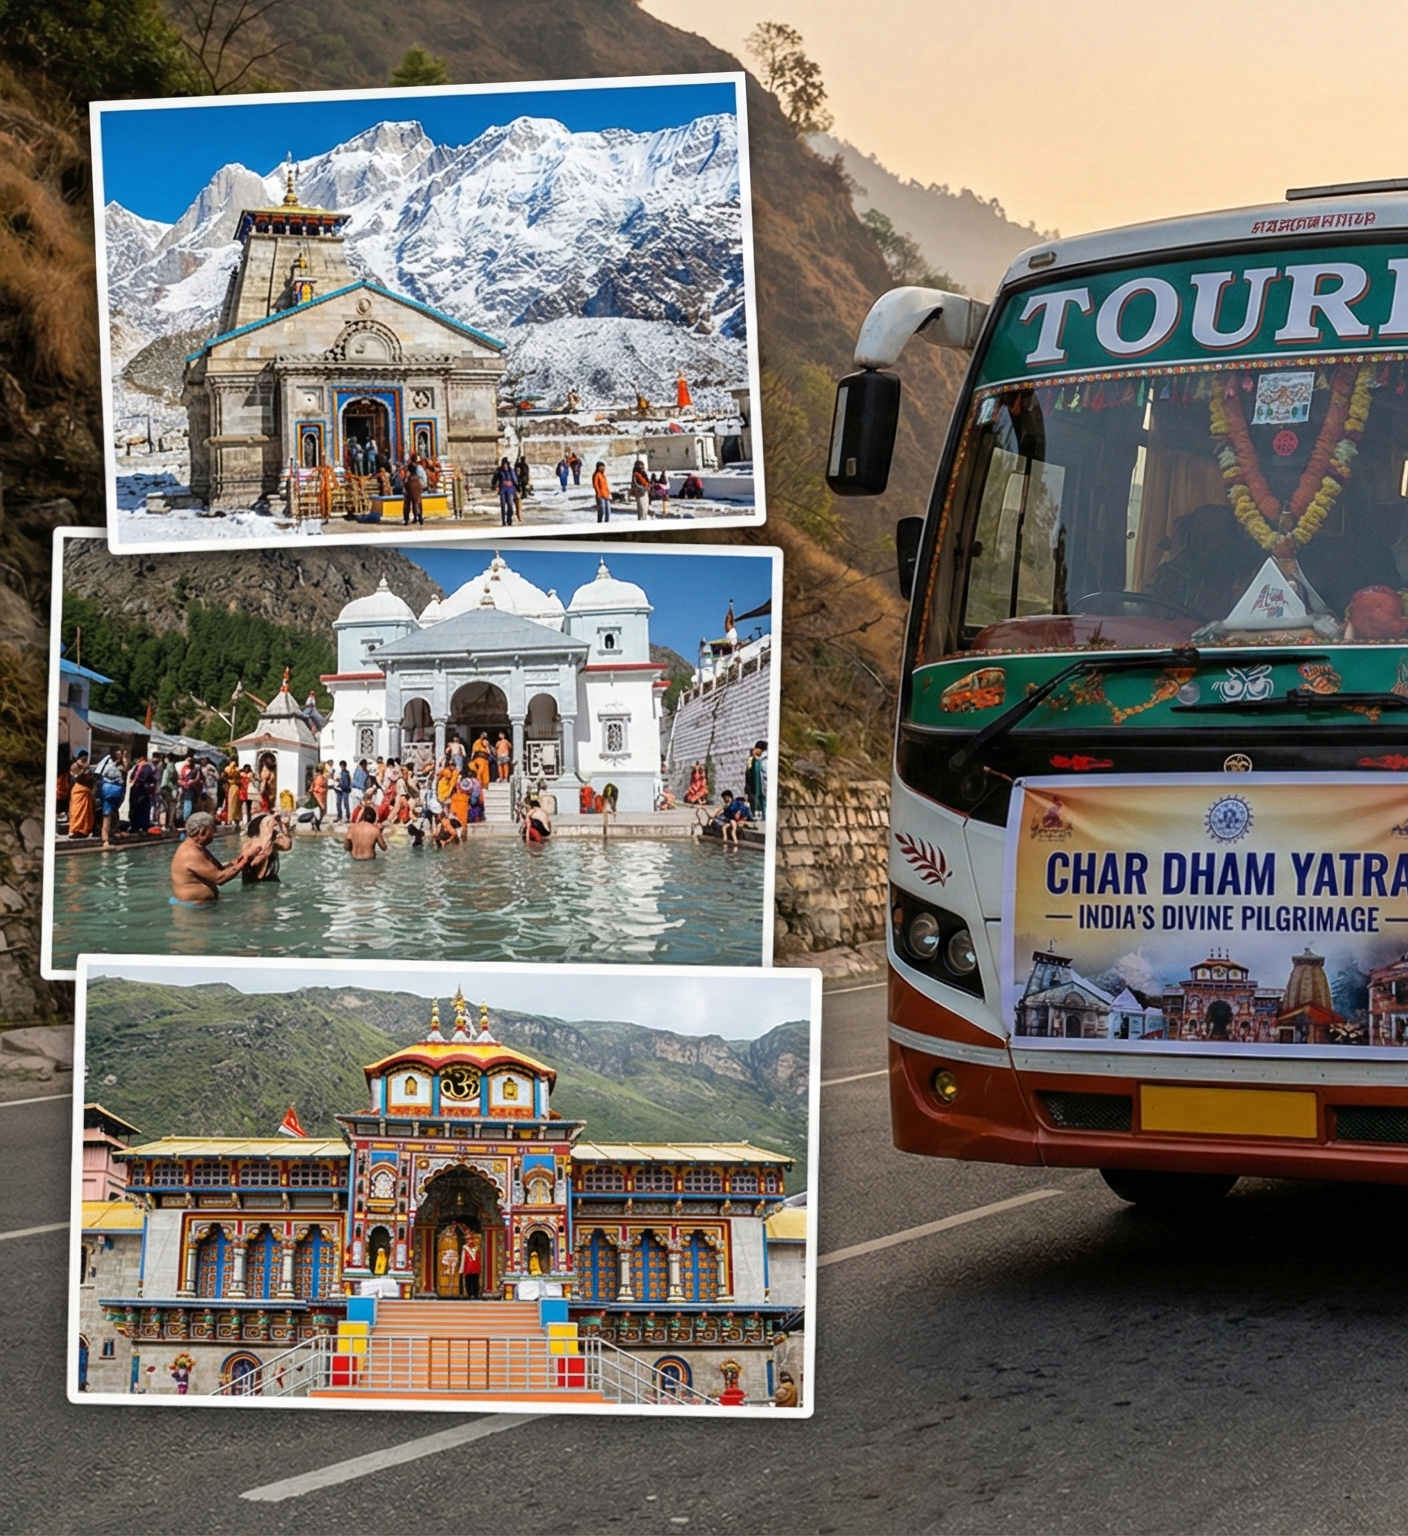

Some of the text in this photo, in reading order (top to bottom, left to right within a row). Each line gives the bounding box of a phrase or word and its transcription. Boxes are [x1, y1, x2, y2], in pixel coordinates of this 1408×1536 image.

[1045, 850, 1149, 896] CHAR
[1161, 851, 1276, 897] DHAM
[1079, 904, 1380, 933] INDIA'S DIVINE PILGRIMAGE
